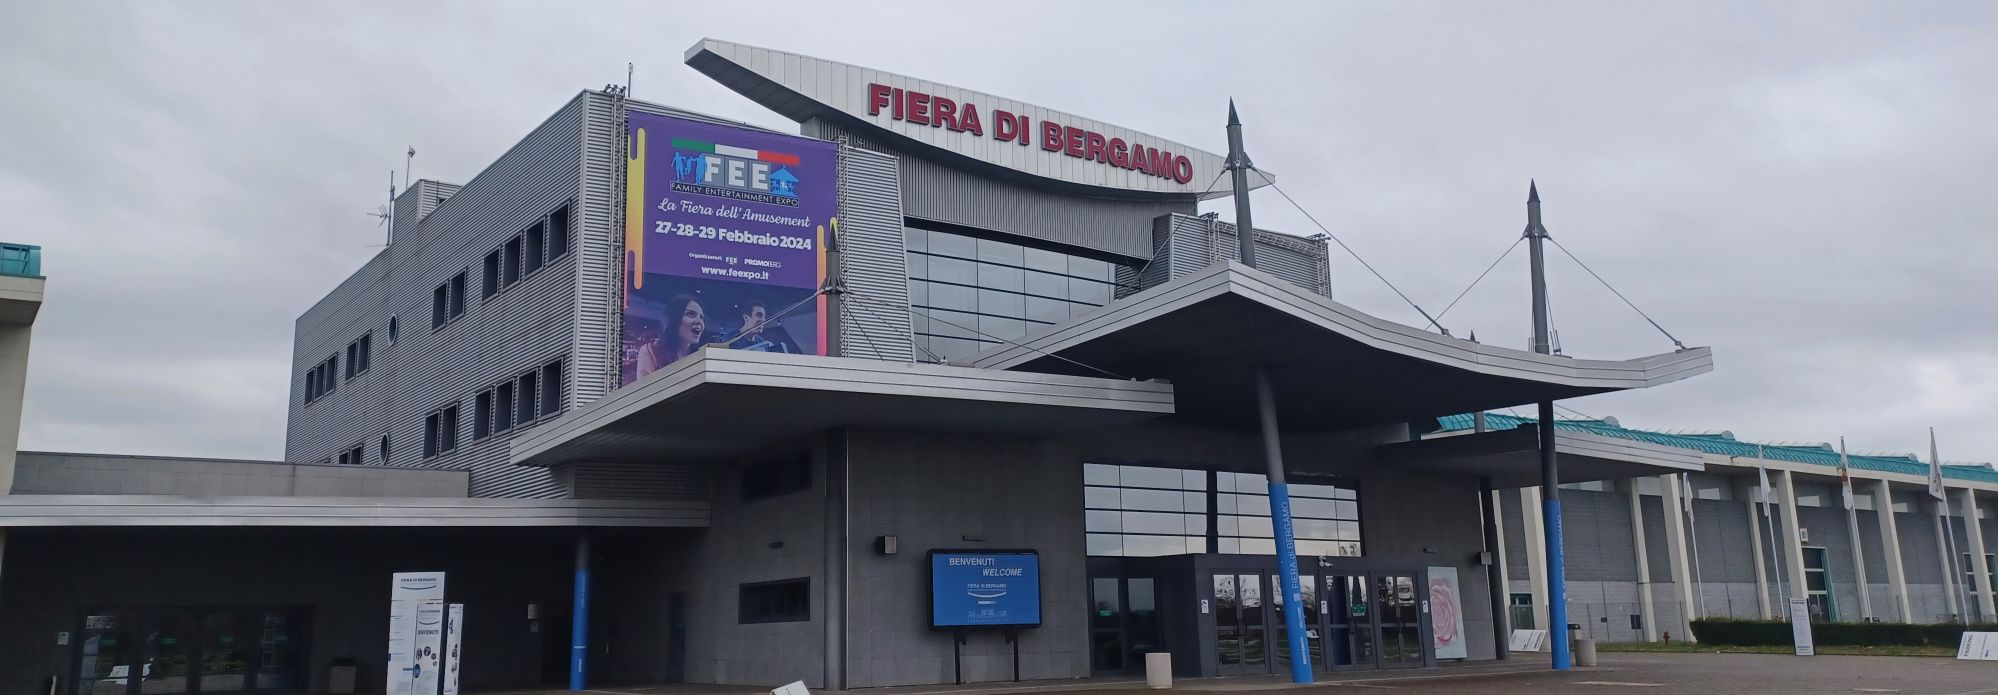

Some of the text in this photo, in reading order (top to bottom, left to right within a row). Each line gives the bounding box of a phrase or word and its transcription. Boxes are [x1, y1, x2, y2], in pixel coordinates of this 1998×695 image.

[867, 82, 1194, 185] FIERA DI BERGAMO
[704, 155, 769, 190] FEE
[657, 198, 677, 212] La
[680, 200, 713, 216] Fiera
[671, 182, 799, 207] FAMILY ENTERTAINMENT EXPO
[655, 220, 812, 250] 27-28-29 Febbraio 2024
[701, 266, 769, 280] www.feexpo.it
[1281, 501, 1294, 549] BERGAMO
[949, 558, 995, 566] BENVENUTI
[982, 568, 1023, 577] WELCOME
[1290, 562, 1300, 589] FIERA
[1963, 634, 1974, 657] PARKING
